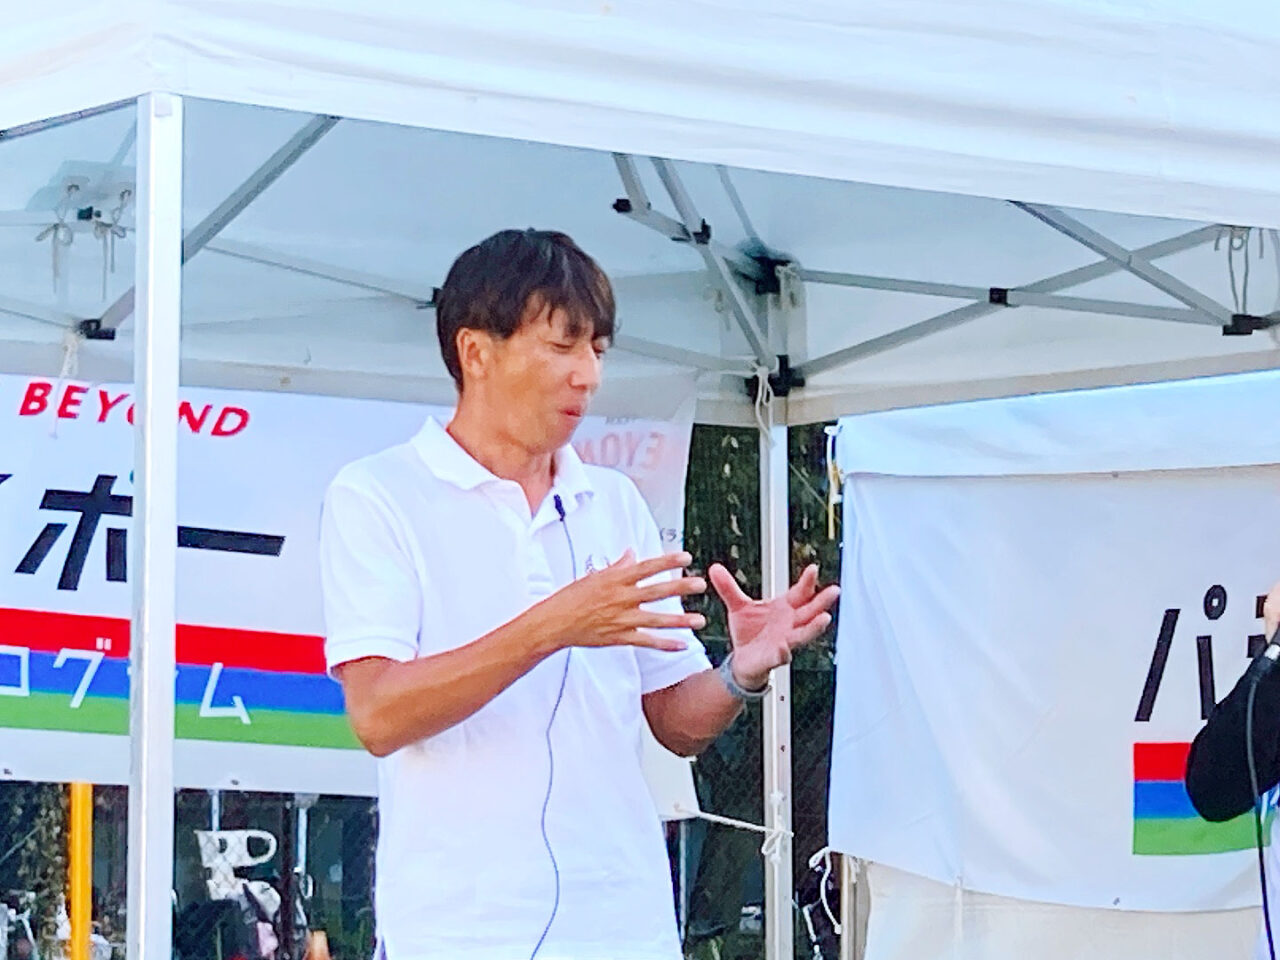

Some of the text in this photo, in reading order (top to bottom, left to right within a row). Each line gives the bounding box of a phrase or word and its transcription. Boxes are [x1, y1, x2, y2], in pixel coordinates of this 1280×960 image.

[19, 381, 250, 437] BEYND
[0, 637, 252, 725] ログム
